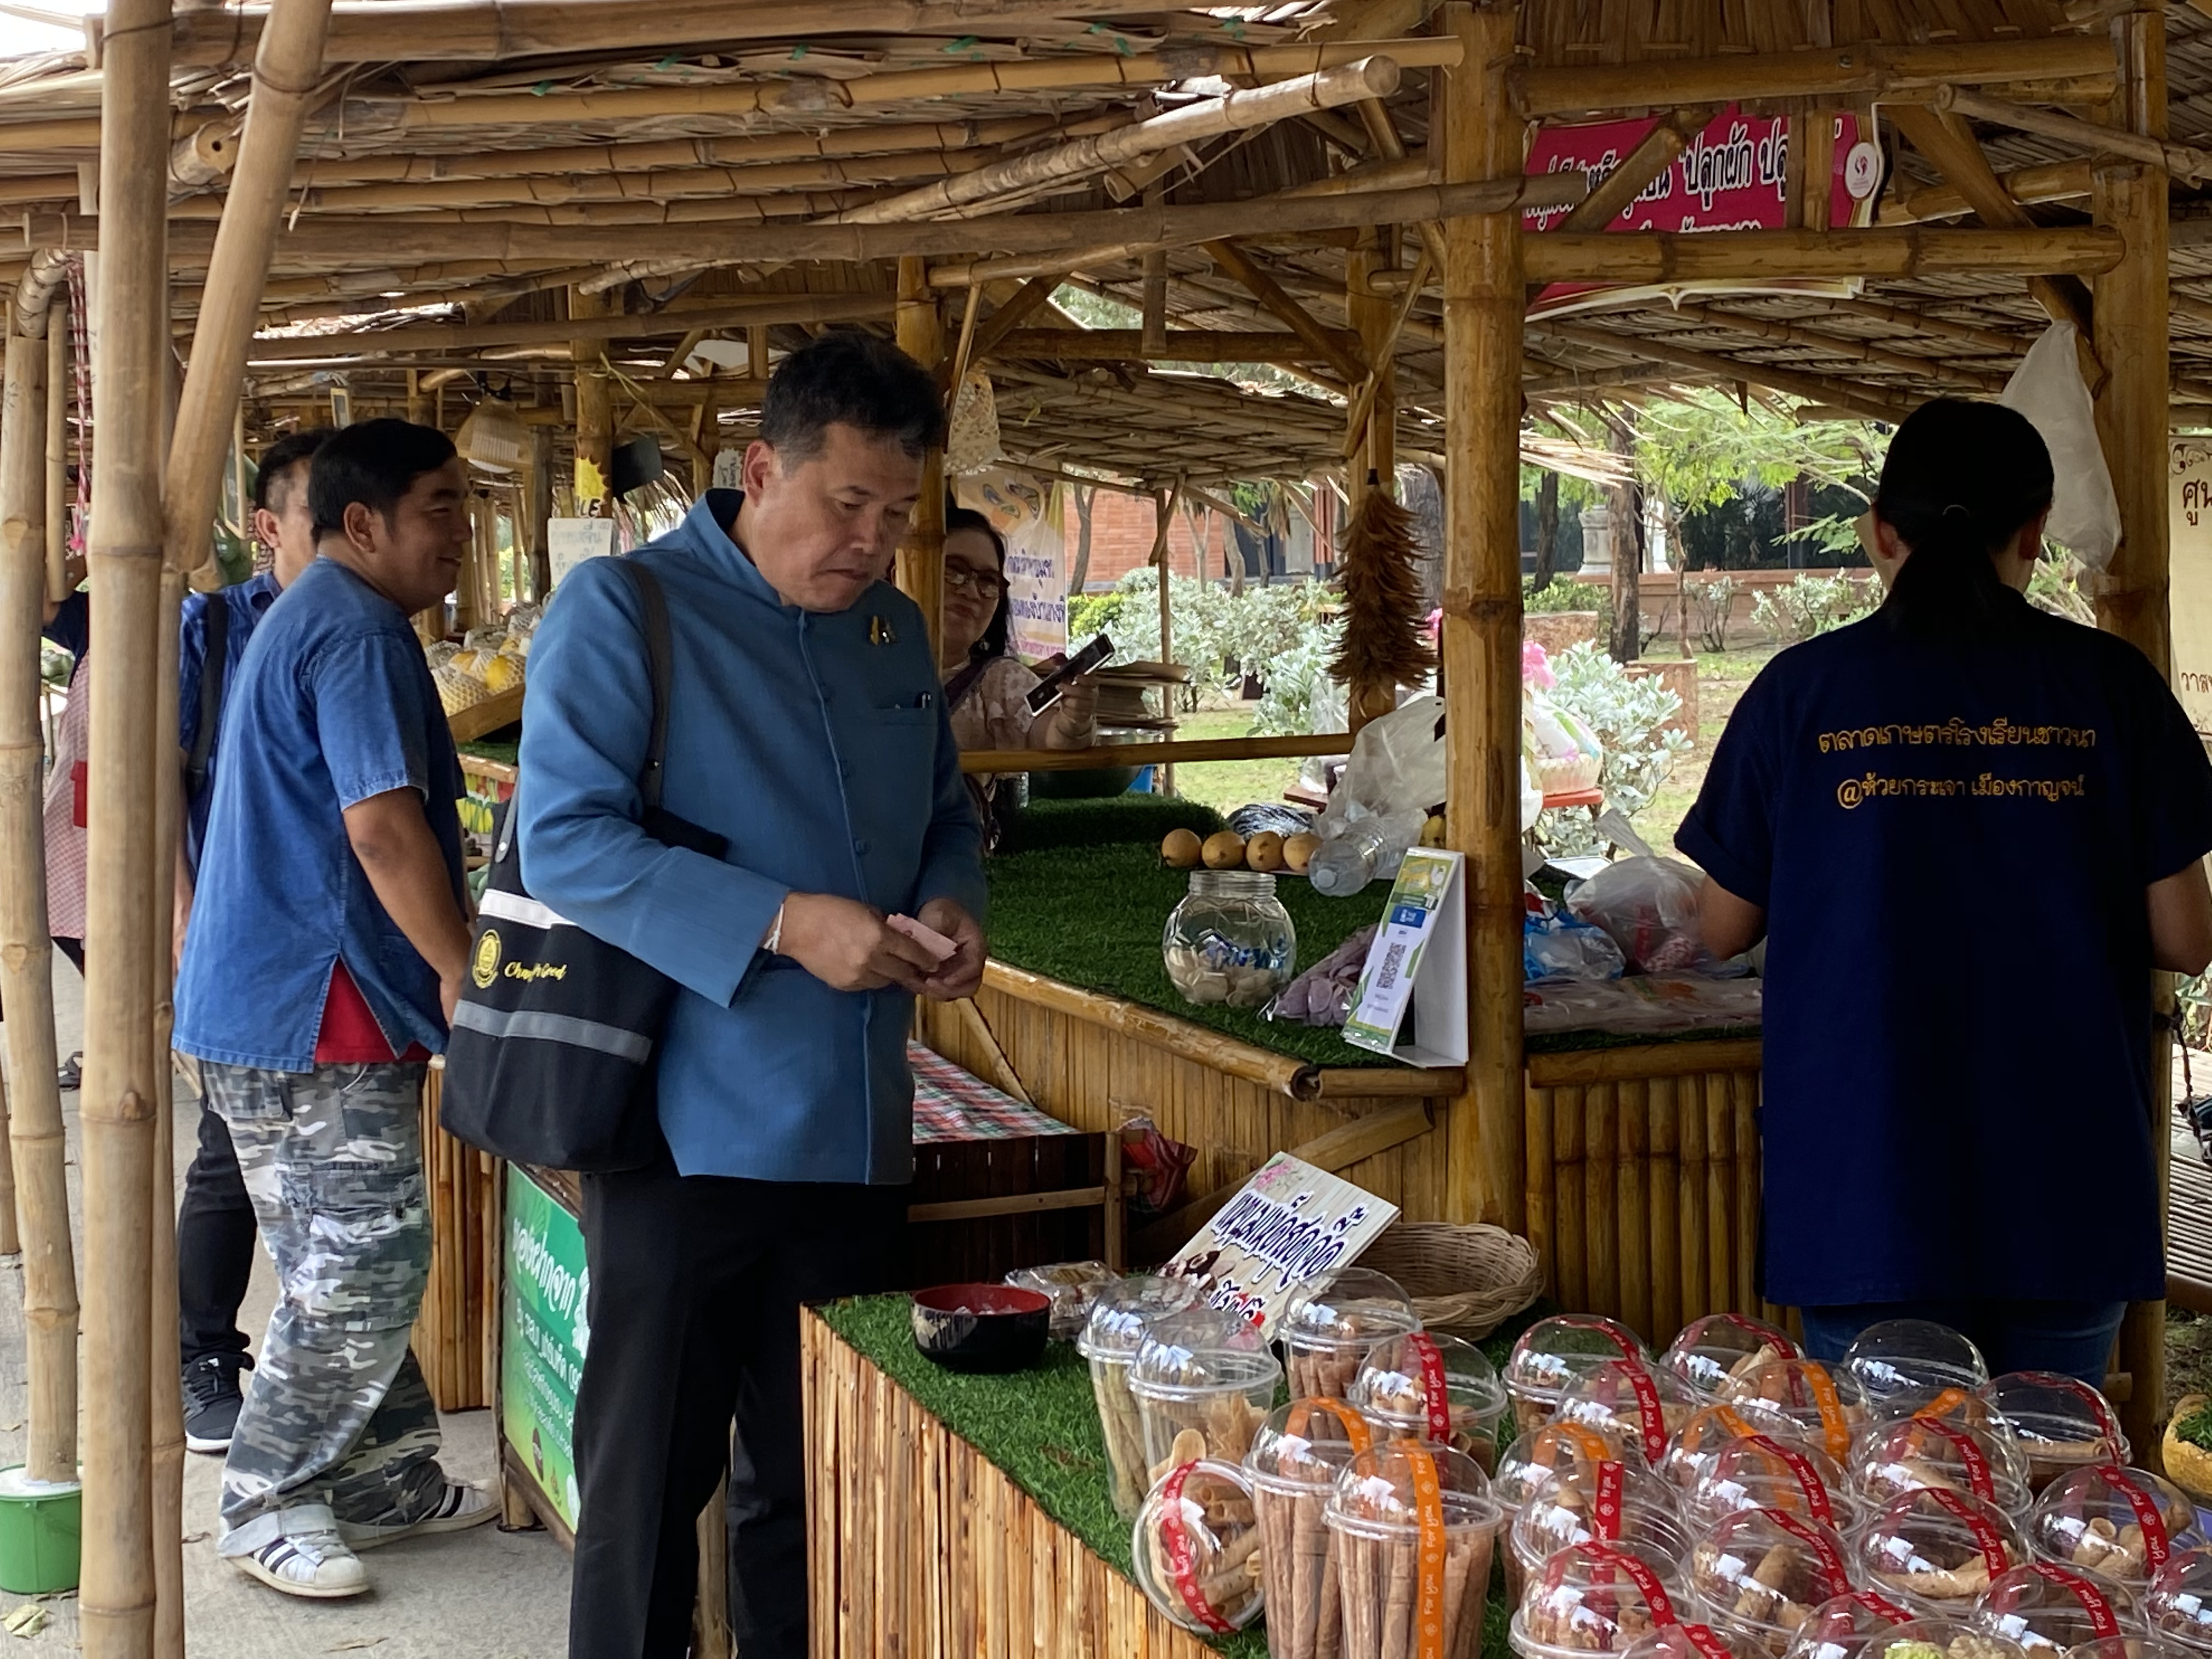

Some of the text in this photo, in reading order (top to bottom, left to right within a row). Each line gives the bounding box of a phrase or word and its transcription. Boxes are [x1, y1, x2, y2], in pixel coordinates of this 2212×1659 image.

[1818, 717, 2097, 754] ตลาดเกษตรโรงเรียนชาวนา
[1836, 772, 2086, 810] @ห้วยกระเจา เมืองกาญจน์
